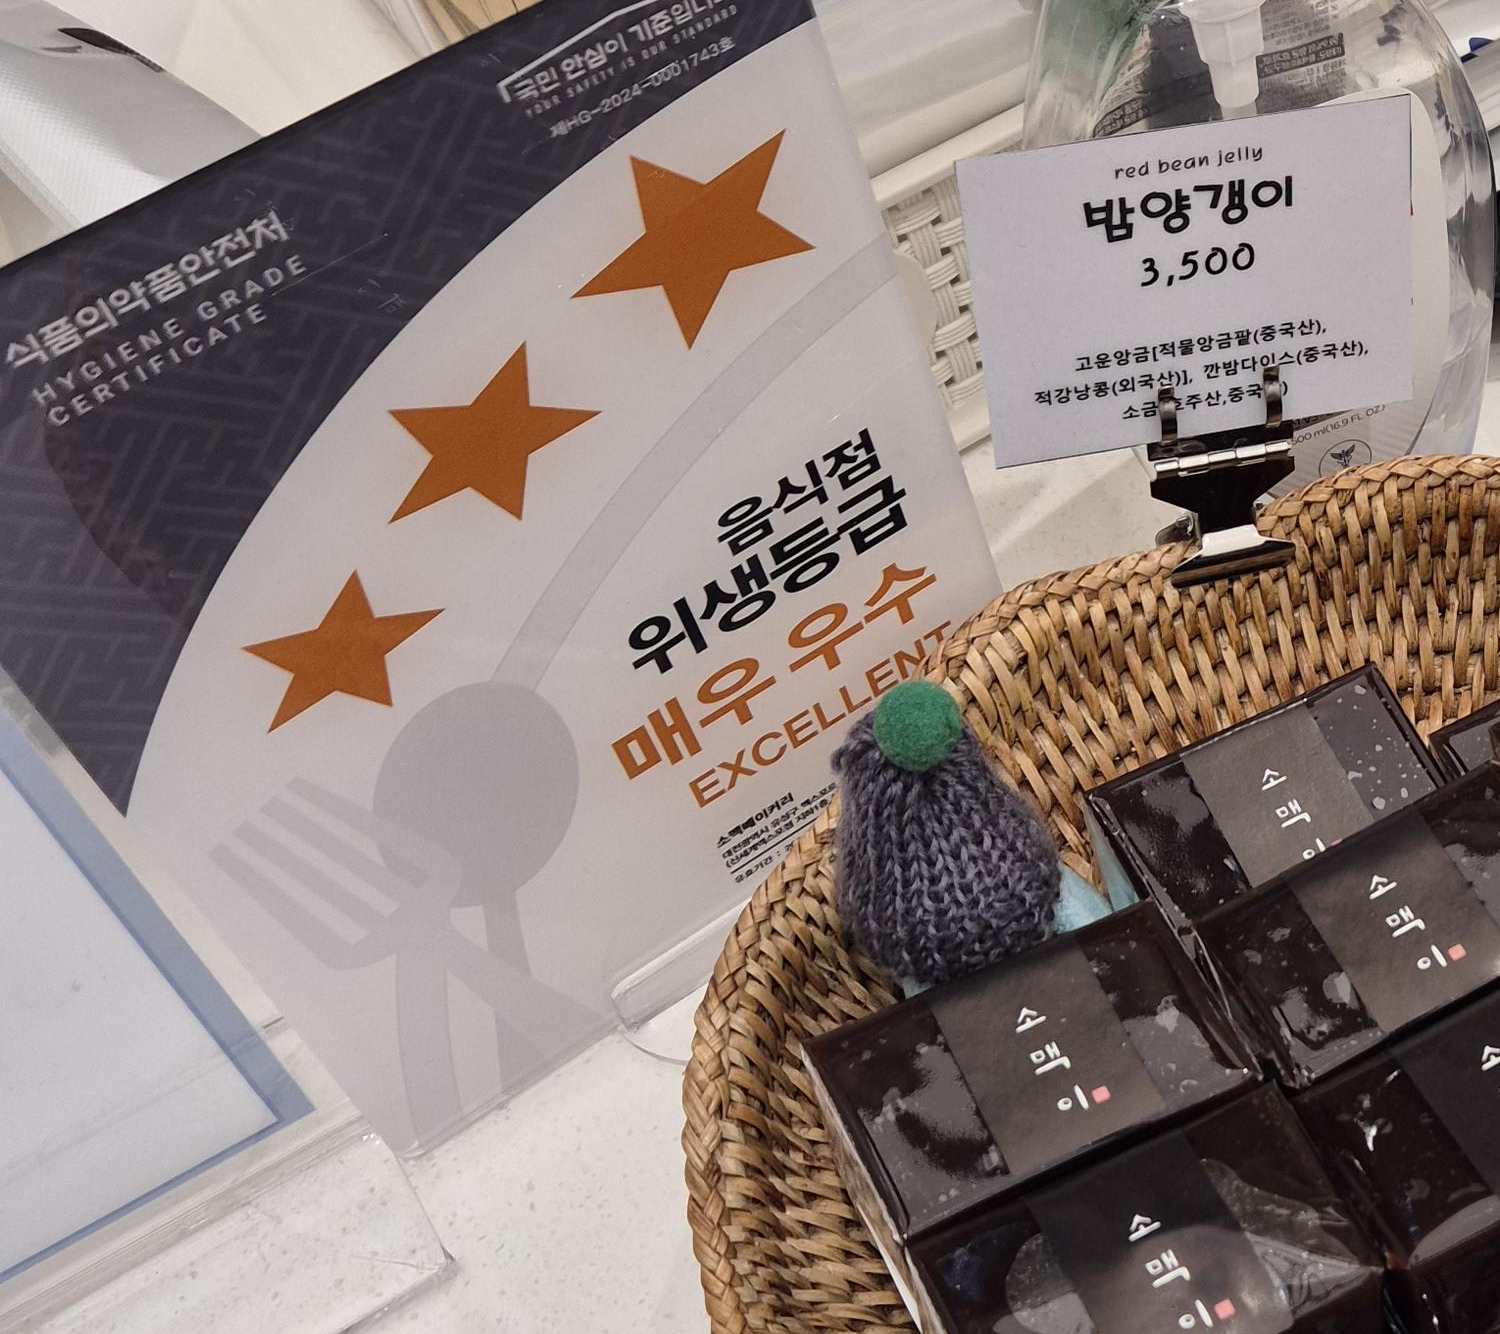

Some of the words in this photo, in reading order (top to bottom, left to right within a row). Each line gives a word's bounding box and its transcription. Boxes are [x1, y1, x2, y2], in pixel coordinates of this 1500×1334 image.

[513, 66, 561, 101] 국민
[560, 31, 630, 80] 안심이
[525, 93, 561, 118] YOUR
[567, 67, 617, 99] SAFETY
[622, 55, 636, 72] IS
[641, 39, 668, 60] OUR
[672, 3, 738, 45] STANDARD
[1083, 176, 1294, 243] 밤양갱이
[1114, 160, 1150, 180] red
[1158, 150, 1211, 174] bean
[1217, 143, 1264, 169] jelly
[4, 208, 290, 369] 식품의약품안전처
[1140, 243, 1256, 288] 3,500
[31, 317, 186, 406] HYGIENE
[196, 253, 308, 322] GRADE
[48, 302, 269, 427] CERTIFICATE
[1122, 380, 1289, 420] 소금주산,중국)
[717, 427, 882, 556] 음식점
[628, 474, 908, 675] 위생등급
[610, 657, 777, 780] 매우
[787, 562, 938, 672] 우수
[688, 619, 952, 808] EXCELLENT
[716, 792, 795, 849] 소맥베이커리
[1261, 768, 1326, 860] 소맥이
[1369, 874, 1447, 970] 소맥이
[1016, 1007, 1090, 1112] 소맥이
[1128, 1213, 1214, 1329] 소맥이
